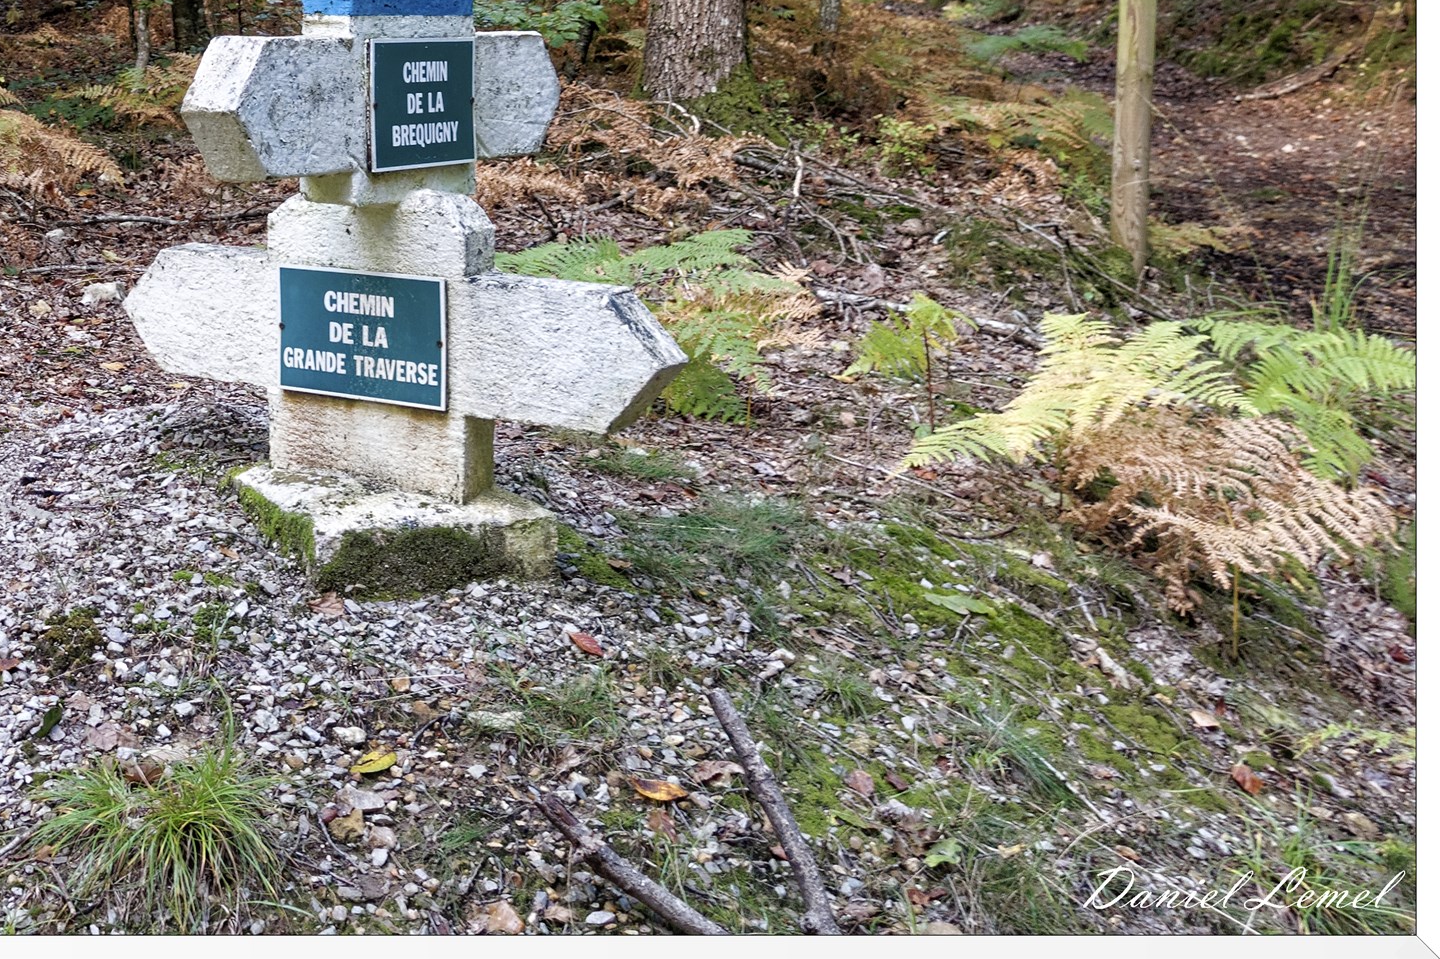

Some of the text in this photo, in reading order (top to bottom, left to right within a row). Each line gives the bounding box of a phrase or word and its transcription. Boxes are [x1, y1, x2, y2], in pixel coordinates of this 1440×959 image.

[402, 60, 448, 83] CHEMIN
[407, 91, 445, 114] DE LA
[392, 120, 459, 147] BREQUIGNY
[323, 290, 395, 318] CHEMIN
[328, 321, 389, 349] DE LA
[283, 346, 439, 386] GRANDE TRAVERSE
